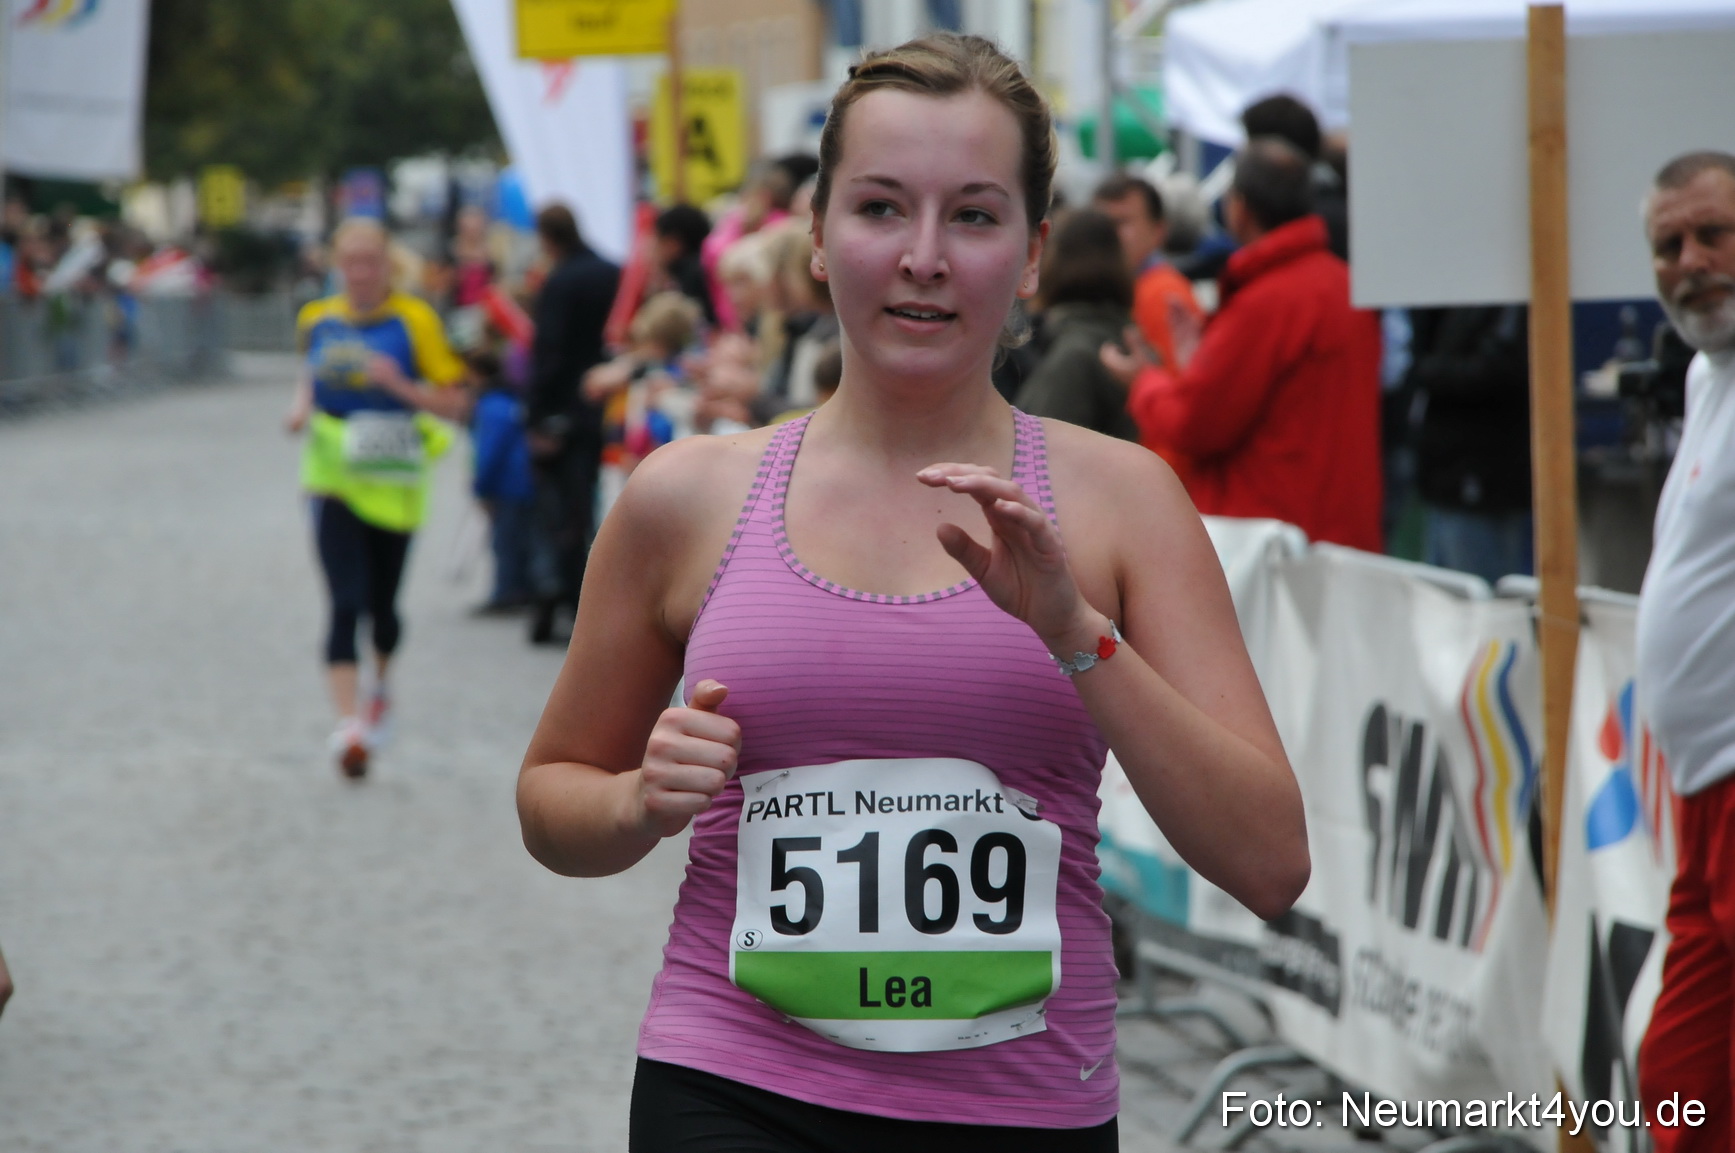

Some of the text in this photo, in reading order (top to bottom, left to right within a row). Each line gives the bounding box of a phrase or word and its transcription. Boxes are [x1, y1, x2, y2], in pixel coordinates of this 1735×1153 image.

[746, 791, 846, 823] PARTL
[855, 788, 1004, 815] Neumarkt
[769, 828, 1027, 936] 5169
[743, 932, 756, 947] S
[859, 967, 933, 1008] Lea
